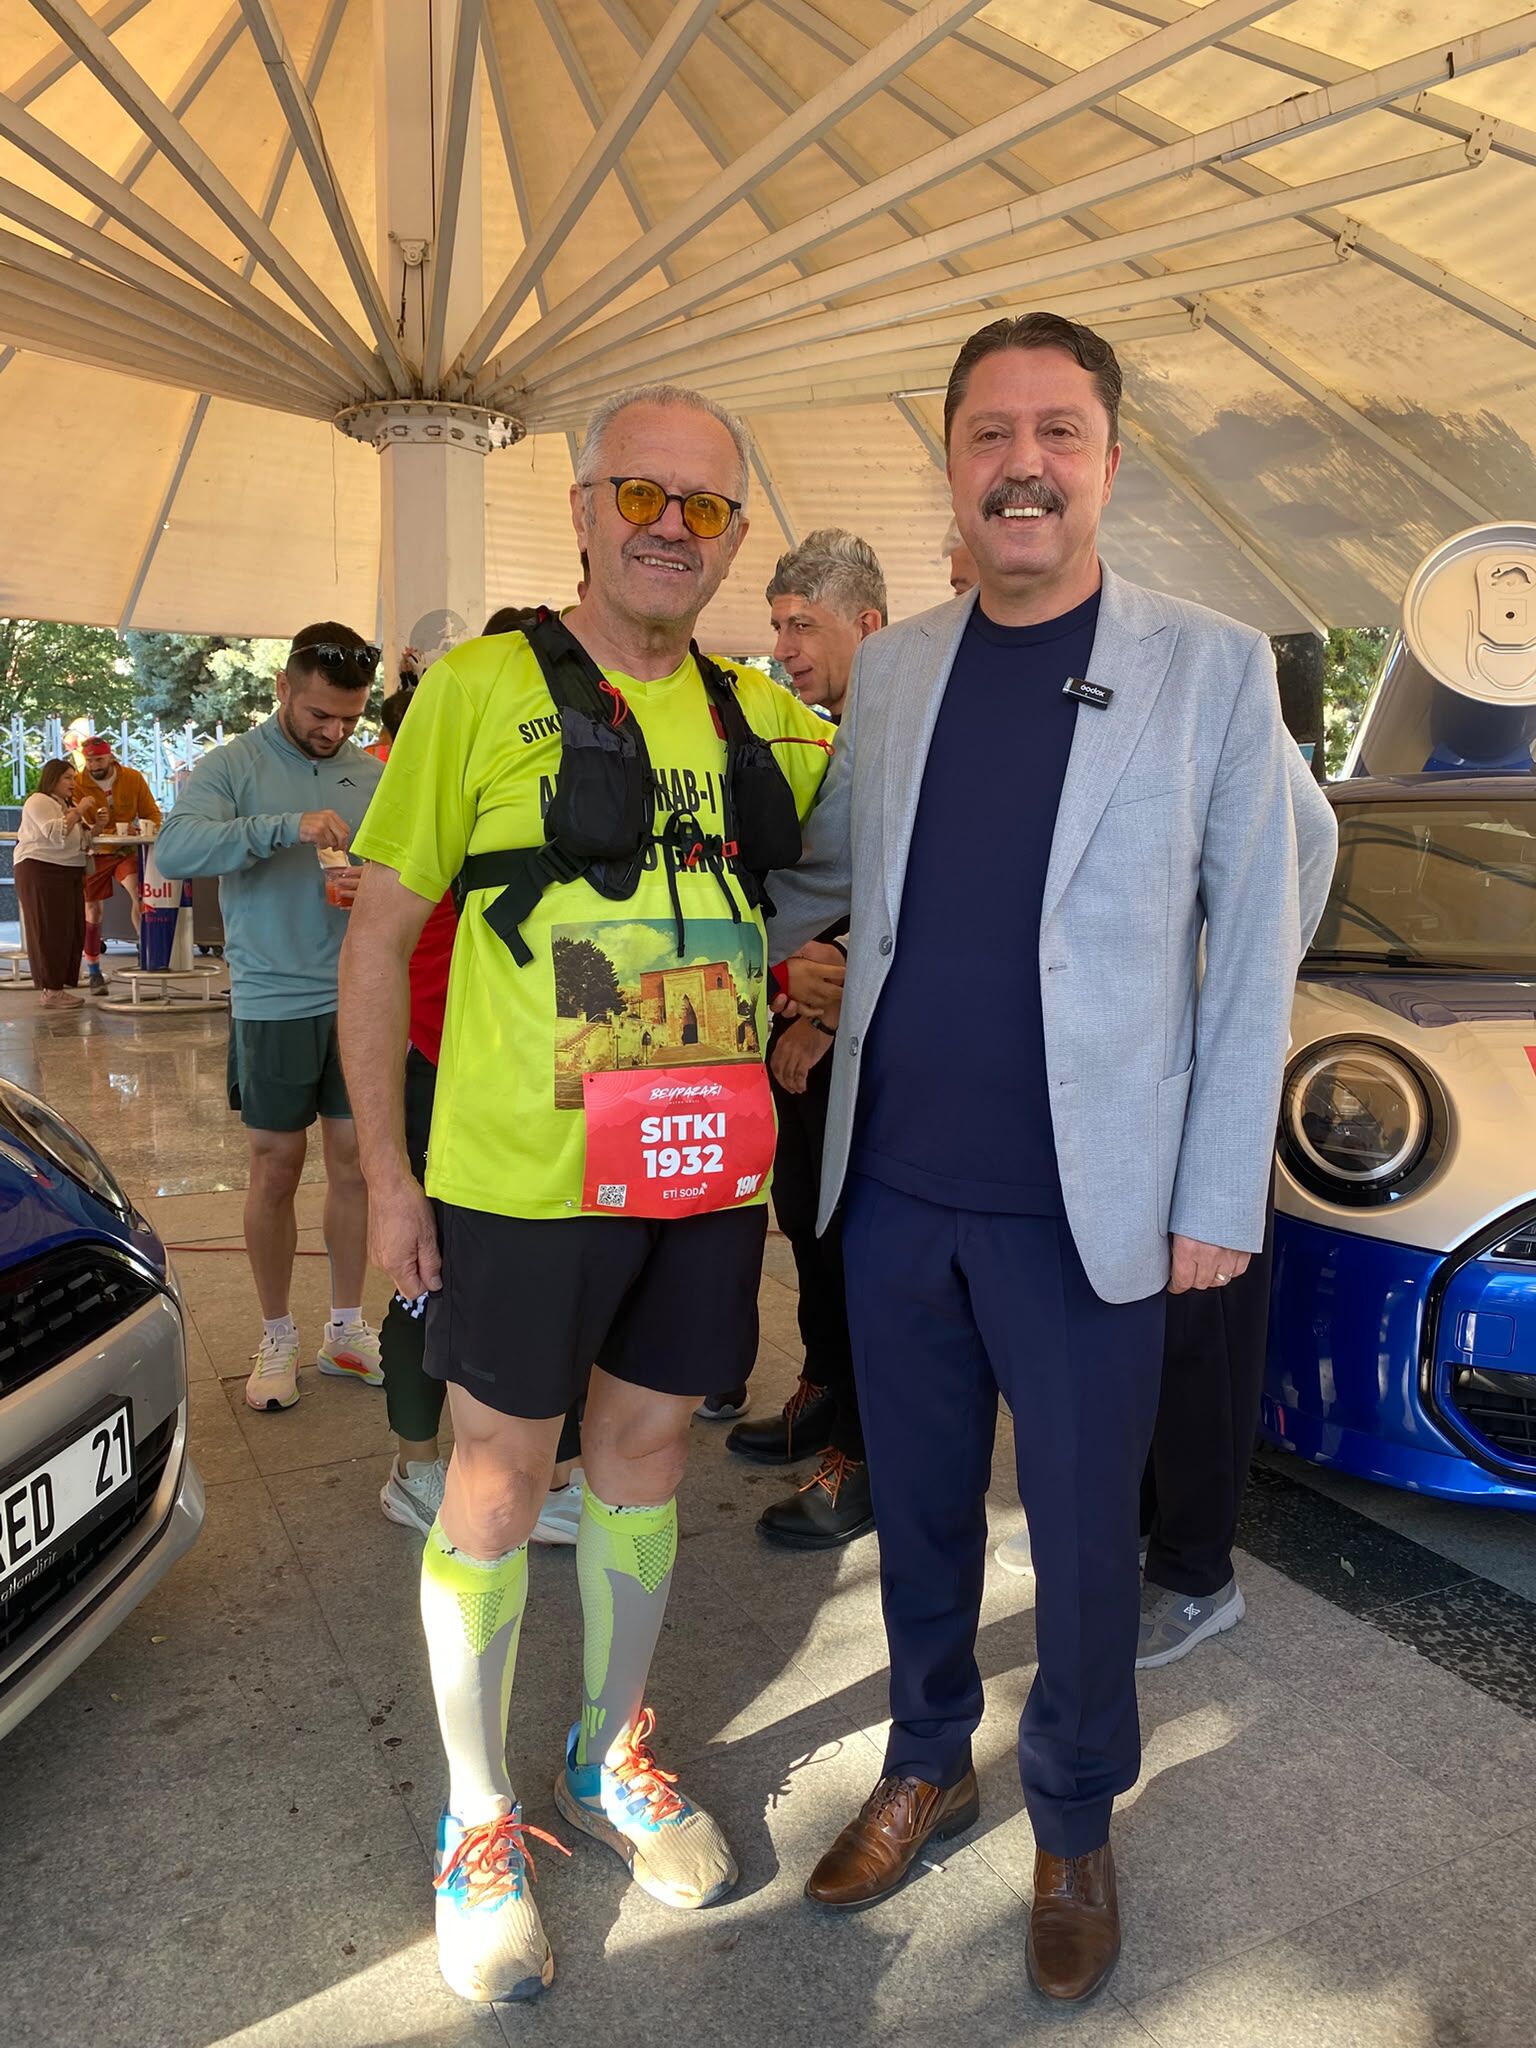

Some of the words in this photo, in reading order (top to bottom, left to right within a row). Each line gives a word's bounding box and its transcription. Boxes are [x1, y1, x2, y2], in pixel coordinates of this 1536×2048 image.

[651, 768, 716, 814] HAB-I
[142, 881, 172, 898] Bull
[640, 1112, 726, 1144] SITKI
[642, 1144, 724, 1179] 1932
[679, 1186, 706, 1198] SODA
[734, 1174, 762, 1198] 19K
[0, 1472, 55, 1574] ED
[91, 1414, 129, 1498] 21
